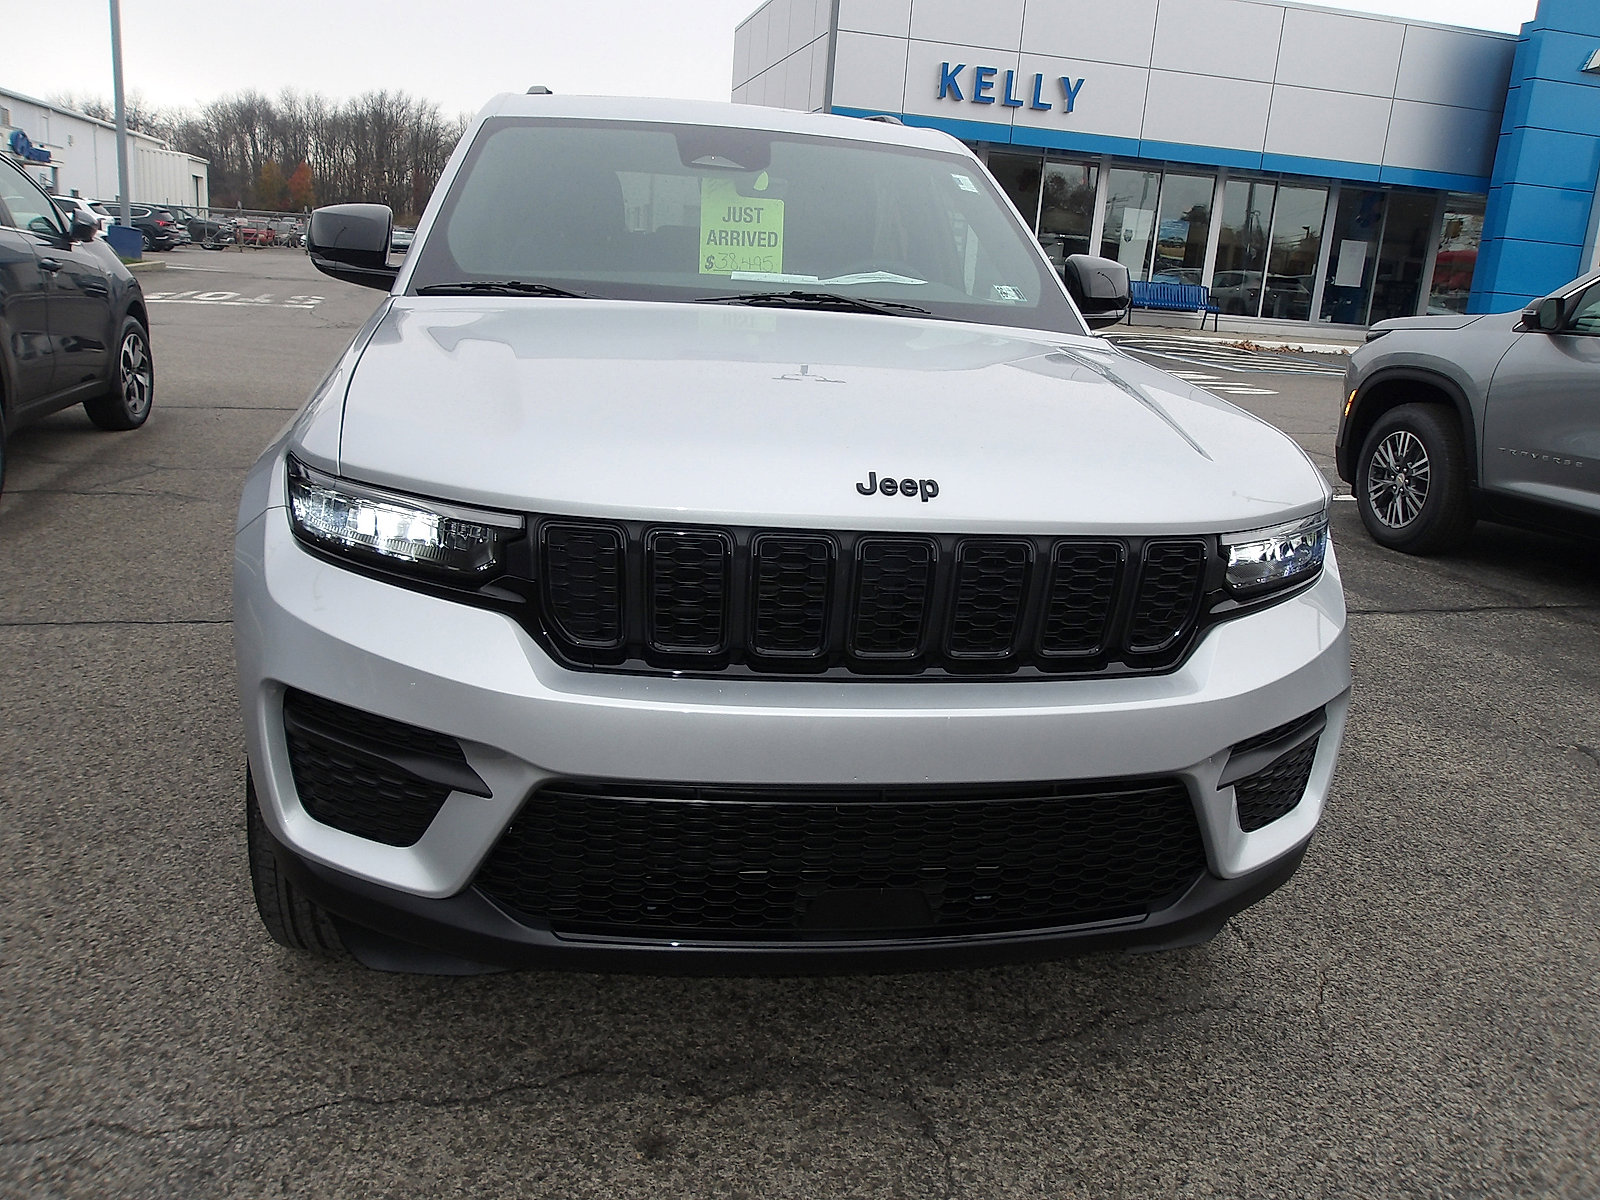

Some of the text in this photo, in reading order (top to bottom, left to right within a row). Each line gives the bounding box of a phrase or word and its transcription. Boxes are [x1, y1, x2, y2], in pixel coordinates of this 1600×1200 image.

[938, 62, 1085, 113] KELLY
[722, 207, 763, 224] JUST
[706, 230, 778, 247] ARRIVED
[855, 471, 940, 502] Jeep
